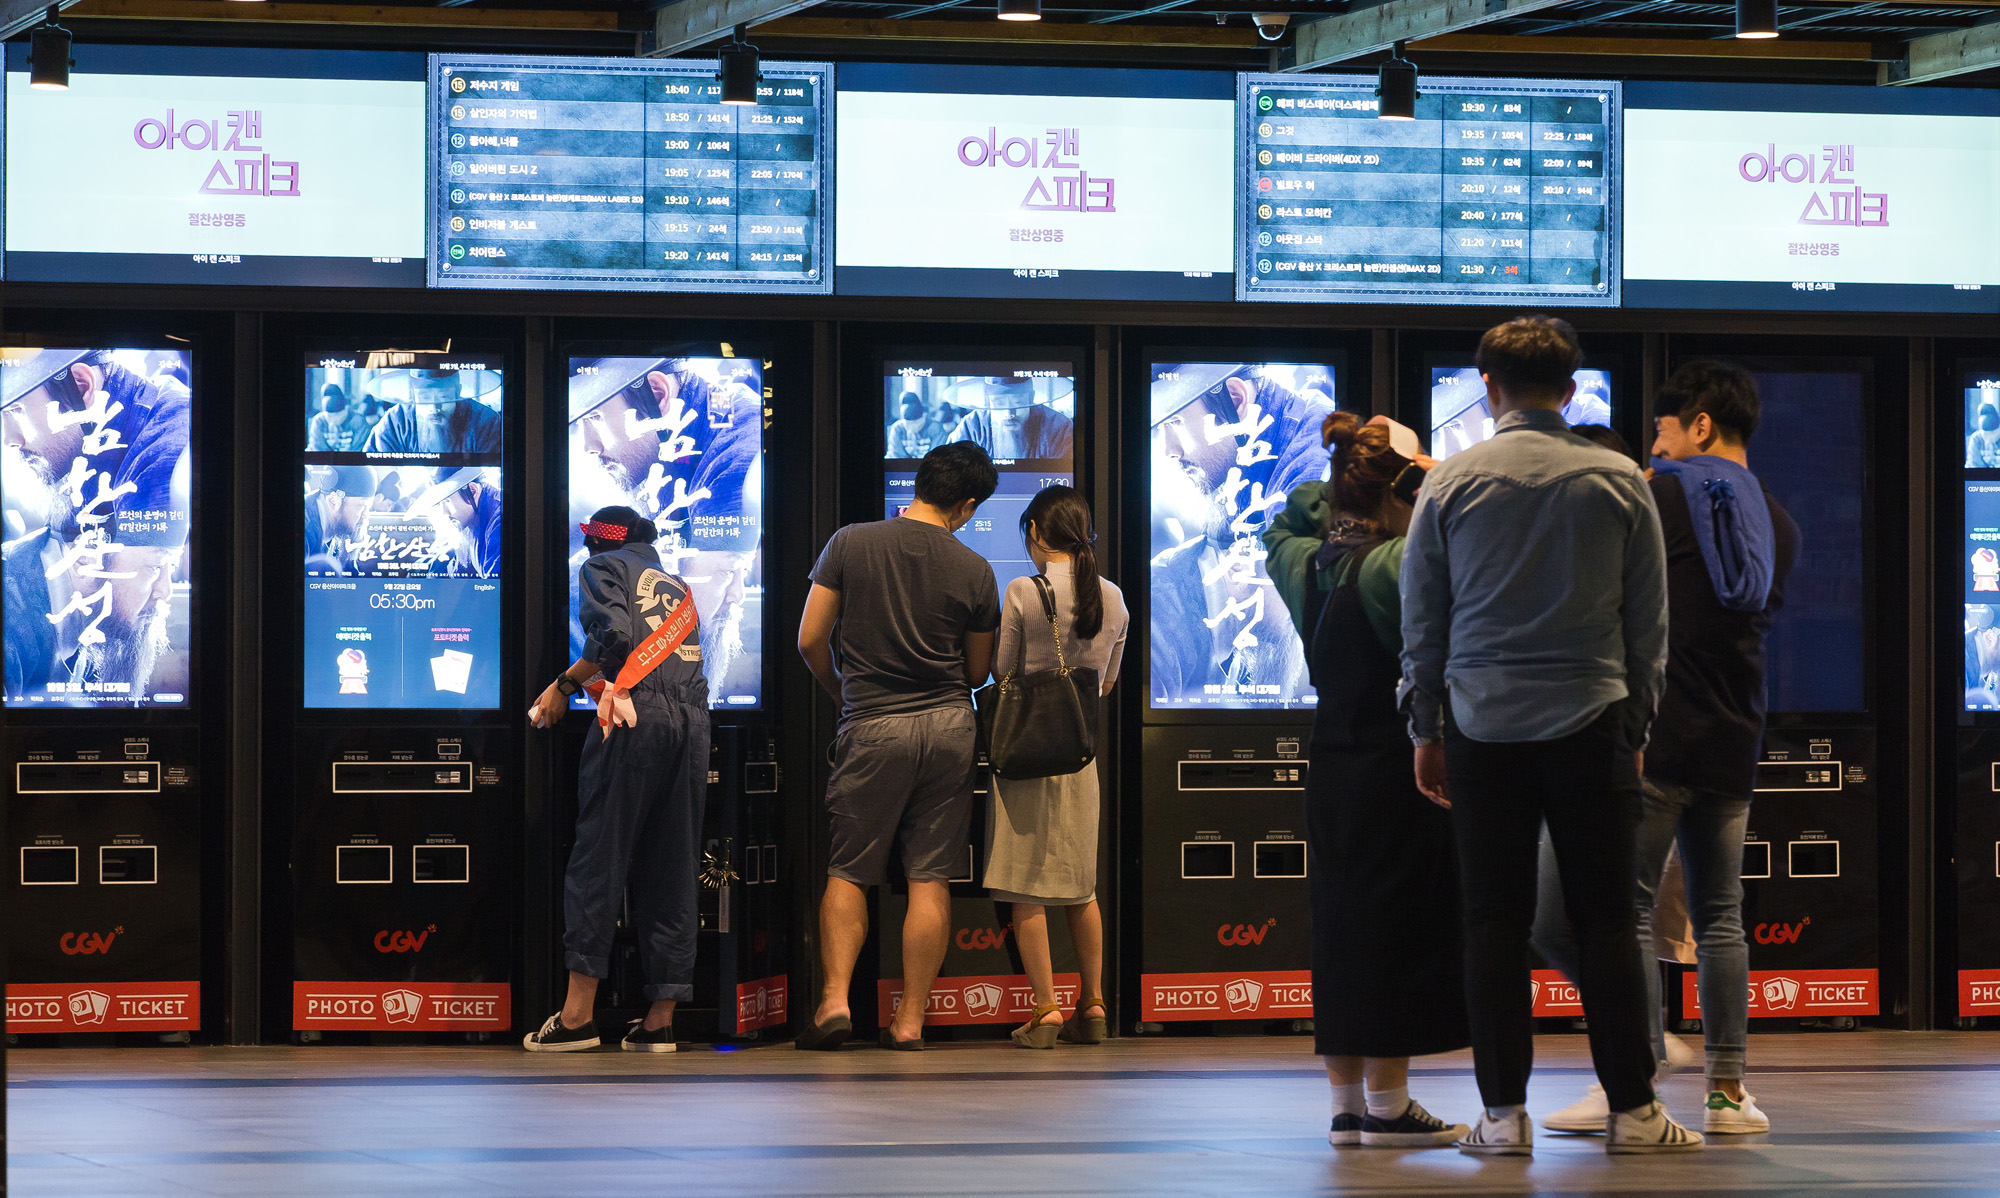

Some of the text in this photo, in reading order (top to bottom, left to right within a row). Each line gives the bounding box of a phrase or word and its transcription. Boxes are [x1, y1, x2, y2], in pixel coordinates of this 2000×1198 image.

[470, 80, 498, 91] 저수지
[500, 81, 519, 91] 게임
[665, 85, 689, 94] 18:40
[707, 86, 721, 95] 117
[757, 87, 773, 96] 0:55
[1276, 99, 1295, 109] 해피
[1462, 103, 1485, 112] 19:30
[469, 108, 507, 118] 살인자의
[510, 108, 537, 119] 기억법
[665, 113, 689, 122] 18:50
[751, 115, 773, 123] 21:25
[134, 108, 262, 151] 아이 캔
[1276, 126, 1294, 136] 그것
[1462, 130, 1484, 139] 19:35
[1543, 132, 1564, 141] 22:25
[664, 140, 689, 149] 19:00
[957, 126, 1080, 168] 아이 캔
[1363, 154, 1380, 165] 2D)
[1461, 157, 1484, 166] 19:35
[1543, 159, 1564, 168] 22:00
[1738, 143, 1855, 184] 아이 캔
[198, 153, 300, 197] 스피크
[508, 164, 528, 175] 도시
[530, 165, 538, 175] Z
[664, 168, 689, 177] 19:05
[751, 170, 773, 179] 22:05
[1019, 170, 1116, 213] 스피크
[1461, 184, 1484, 193] 20:10
[1503, 185, 1521, 194] 12석
[1543, 186, 1564, 194] 20:10
[664, 195, 689, 205] 19:10
[1796, 185, 1889, 228] 스피크
[188, 212, 246, 227] 절찬상영중
[1276, 207, 1302, 217] 라스트
[1461, 211, 1484, 220] 20:40
[509, 219, 537, 230] 게스트
[664, 223, 689, 232] 19:15
[708, 224, 727, 234] 24석
[751, 225, 772, 234] 23:50
[1009, 228, 1064, 243] 절찬상영중
[1305, 234, 1323, 244] 스타
[1461, 238, 1484, 247] 21:20
[1501, 239, 1522, 248] 111석
[469, 247, 506, 258] 치어댄스
[664, 251, 689, 260] 19:20
[750, 253, 772, 261] 24:15
[1788, 242, 1840, 256] 절찬상영중
[192, 254, 208, 264] 아이
[218, 254, 241, 264] 스피크
[1013, 268, 1028, 278] 아이
[1038, 269, 1059, 279] 스피크
[1461, 265, 1484, 274] 21:30
[1505, 266, 1518, 276] 3석
[1792, 282, 1806, 291] 아이
[1815, 282, 1836, 291] 스피크
[370, 593, 435, 611] 05:30pm
[955, 928, 1007, 950] CGV
[1217, 923, 1269, 946] CGV
[1754, 922, 1803, 945] CGV
[60, 932, 115, 955] CGV
[374, 930, 428, 953] CGV
[892, 991, 1074, 1010] PTO TICET
[1155, 988, 1312, 1006] PHOTO TICK
[1808, 986, 1866, 1001] TICKET
[6, 1000, 185, 1017] HOTO TICKET
[308, 1000, 496, 1015] PHOTO TICKET
